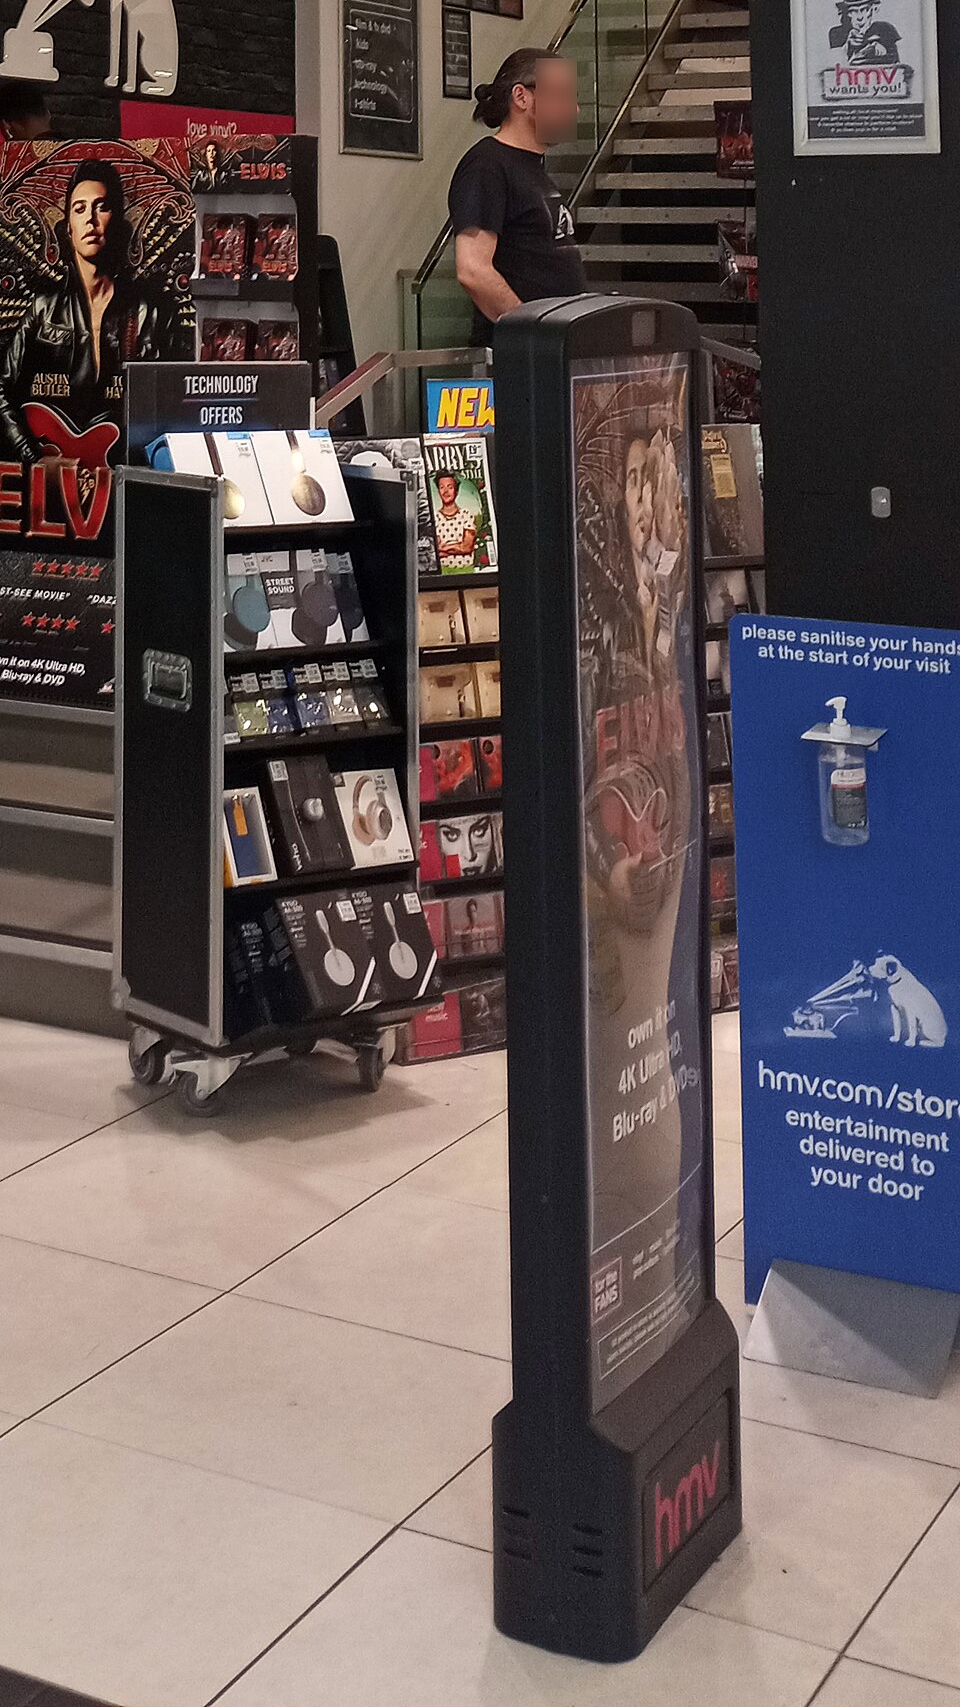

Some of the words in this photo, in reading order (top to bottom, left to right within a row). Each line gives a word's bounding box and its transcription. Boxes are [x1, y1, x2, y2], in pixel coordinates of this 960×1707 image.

[835, 63, 898, 86] hmv
[829, 84, 869, 94] wants
[873, 83, 901, 98] you!
[187, 118, 207, 135] love
[241, 162, 287, 180] ELVIS
[33, 373, 70, 385] AUSTIN
[184, 375, 259, 395] TECHNOLOGY
[32, 384, 70, 397] BUTLER
[200, 406, 243, 426] OFFERS
[265, 577, 294, 586] STREET
[268, 585, 295, 595] SOUND
[34, 590, 70, 601] MOVIE"
[742, 624, 796, 642] please
[800, 630, 866, 648] sanitise
[869, 637, 908, 653] your
[18, 659, 30, 668] on
[30, 658, 44, 669] 4K
[44, 659, 67, 672] Ultra
[758, 644, 775, 659] at
[778, 645, 804, 661] the
[809, 649, 849, 666] start
[853, 652, 870, 668] of
[872, 657, 912, 671] your
[915, 658, 951, 674] visit
[0, 669, 34, 685] Blu-ray
[34, 673, 42, 683] &
[43, 674, 65, 686] DVD
[628, 1017, 653, 1049] own
[618, 1062, 636, 1094] 4K
[640, 1050, 665, 1084] Ultra
[758, 1060, 960, 1120] hmv.com/stor
[613, 1097, 658, 1143] Blu-ray
[785, 1109, 950, 1153] entertainment
[799, 1135, 904, 1172] delivered
[911, 1153, 936, 1177] to
[810, 1166, 862, 1190] your
[868, 1173, 925, 1202] door
[594, 1284, 619, 1314] FANS
[655, 1441, 720, 1567] hmv
